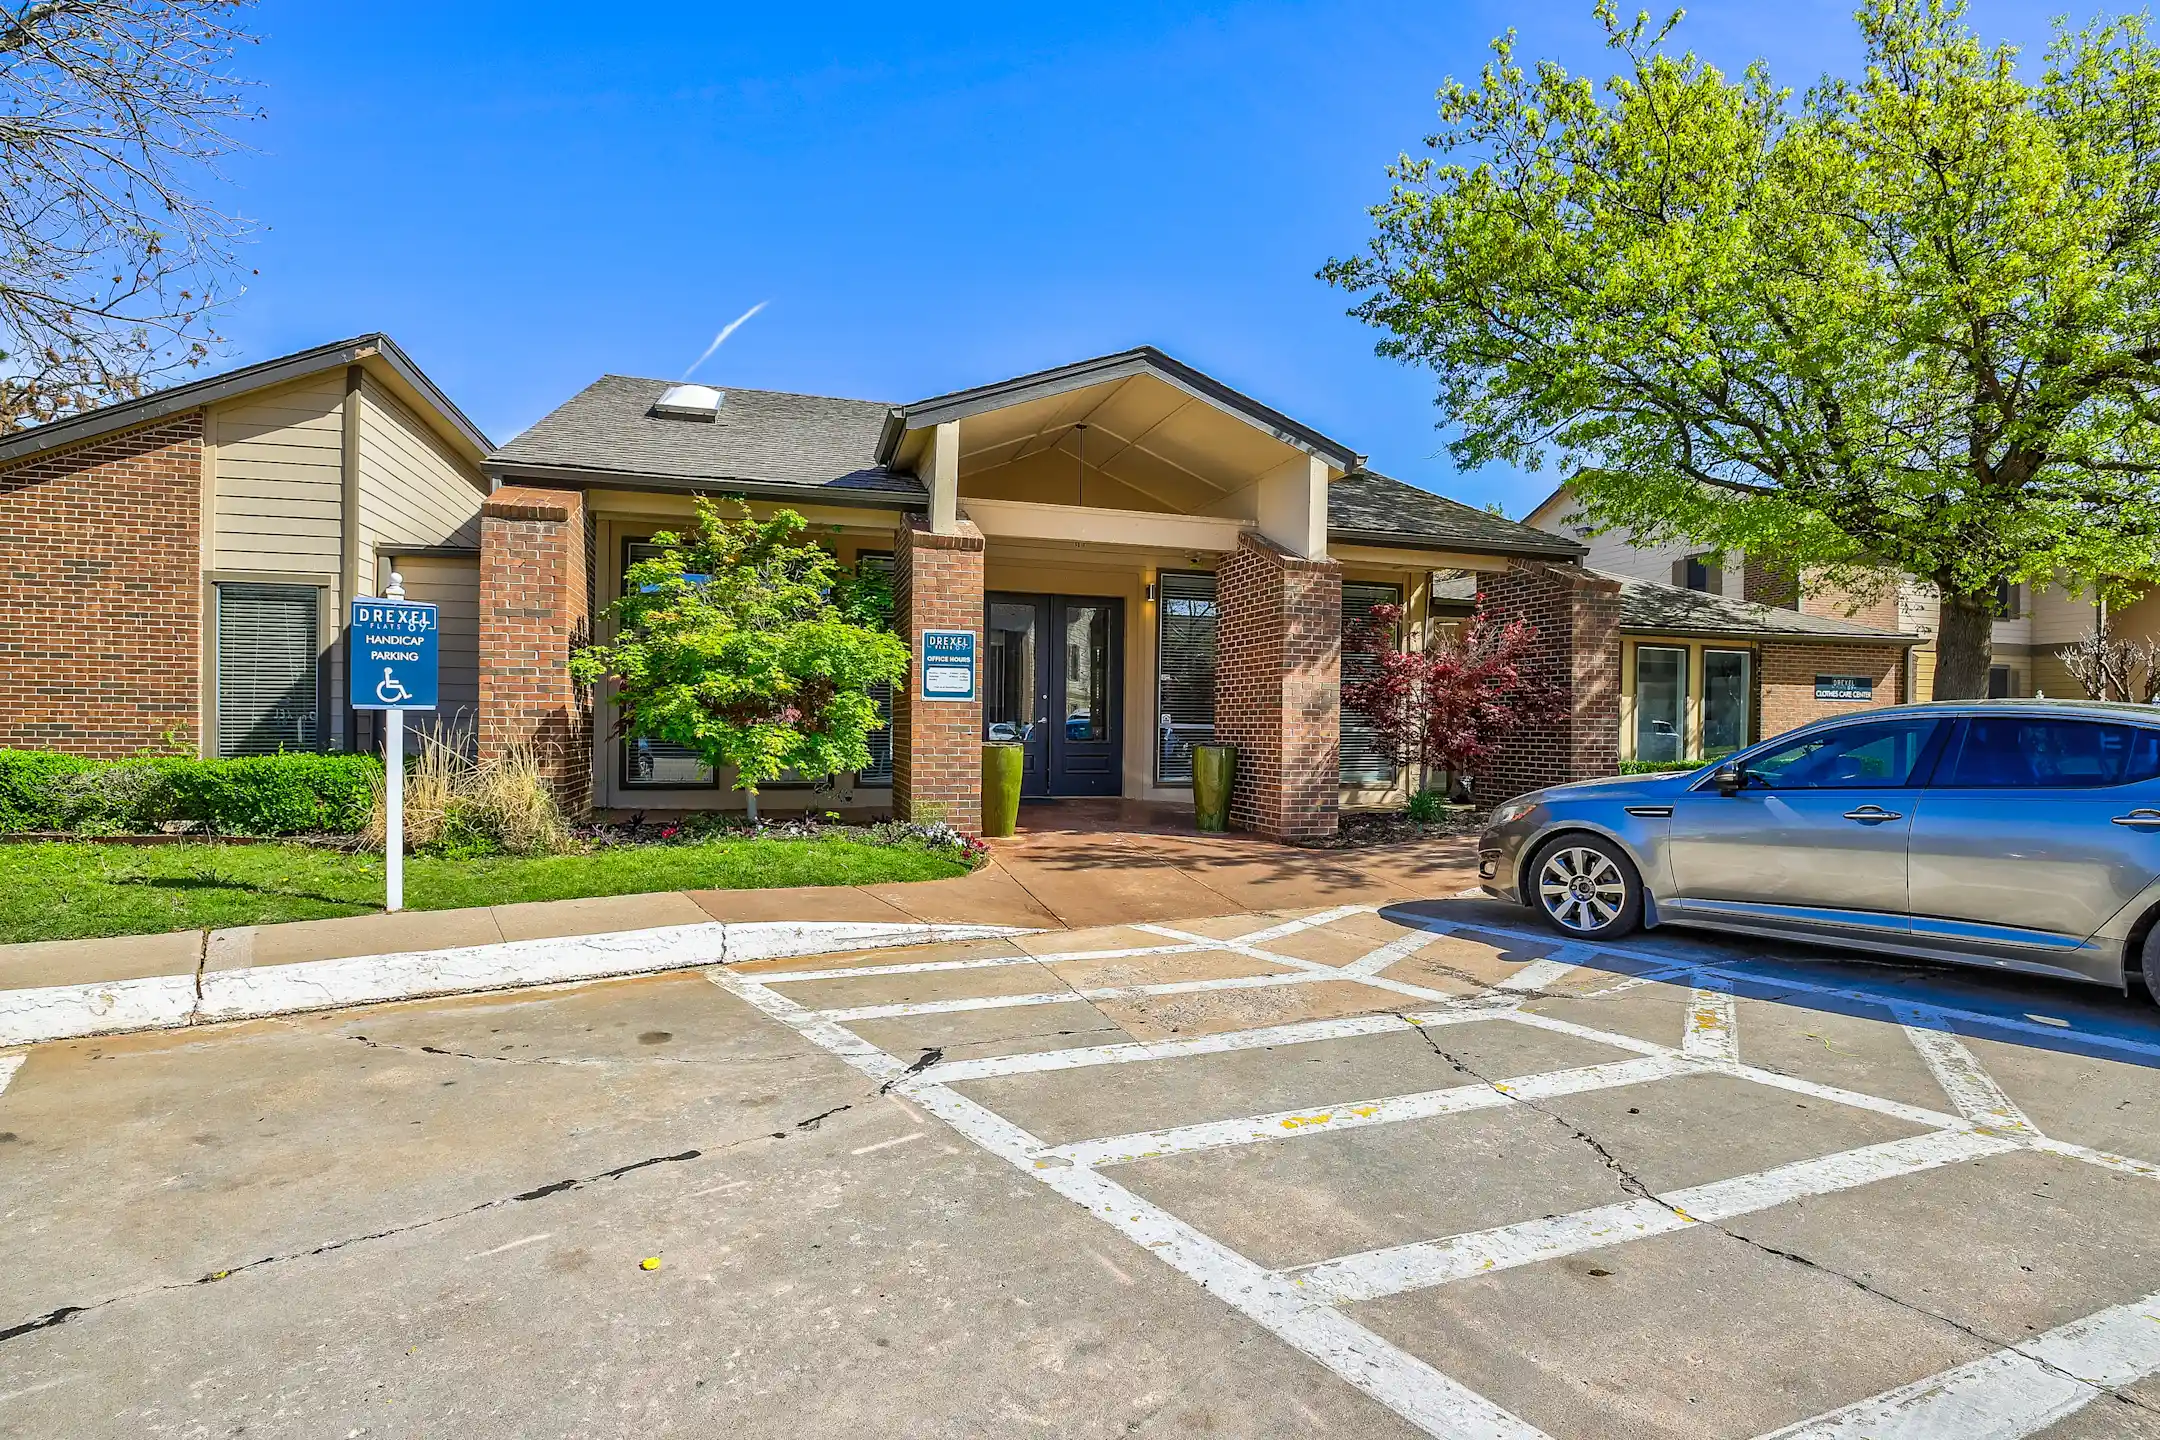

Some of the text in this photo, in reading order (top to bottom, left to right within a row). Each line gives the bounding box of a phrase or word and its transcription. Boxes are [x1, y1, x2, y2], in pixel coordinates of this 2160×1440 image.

[360, 608, 430, 624] DREXEL
[408, 618, 426, 632] 89
[366, 634, 424, 646] HANDICAP
[930, 636, 968, 646] DREXEL
[371, 650, 419, 661] PARKING
